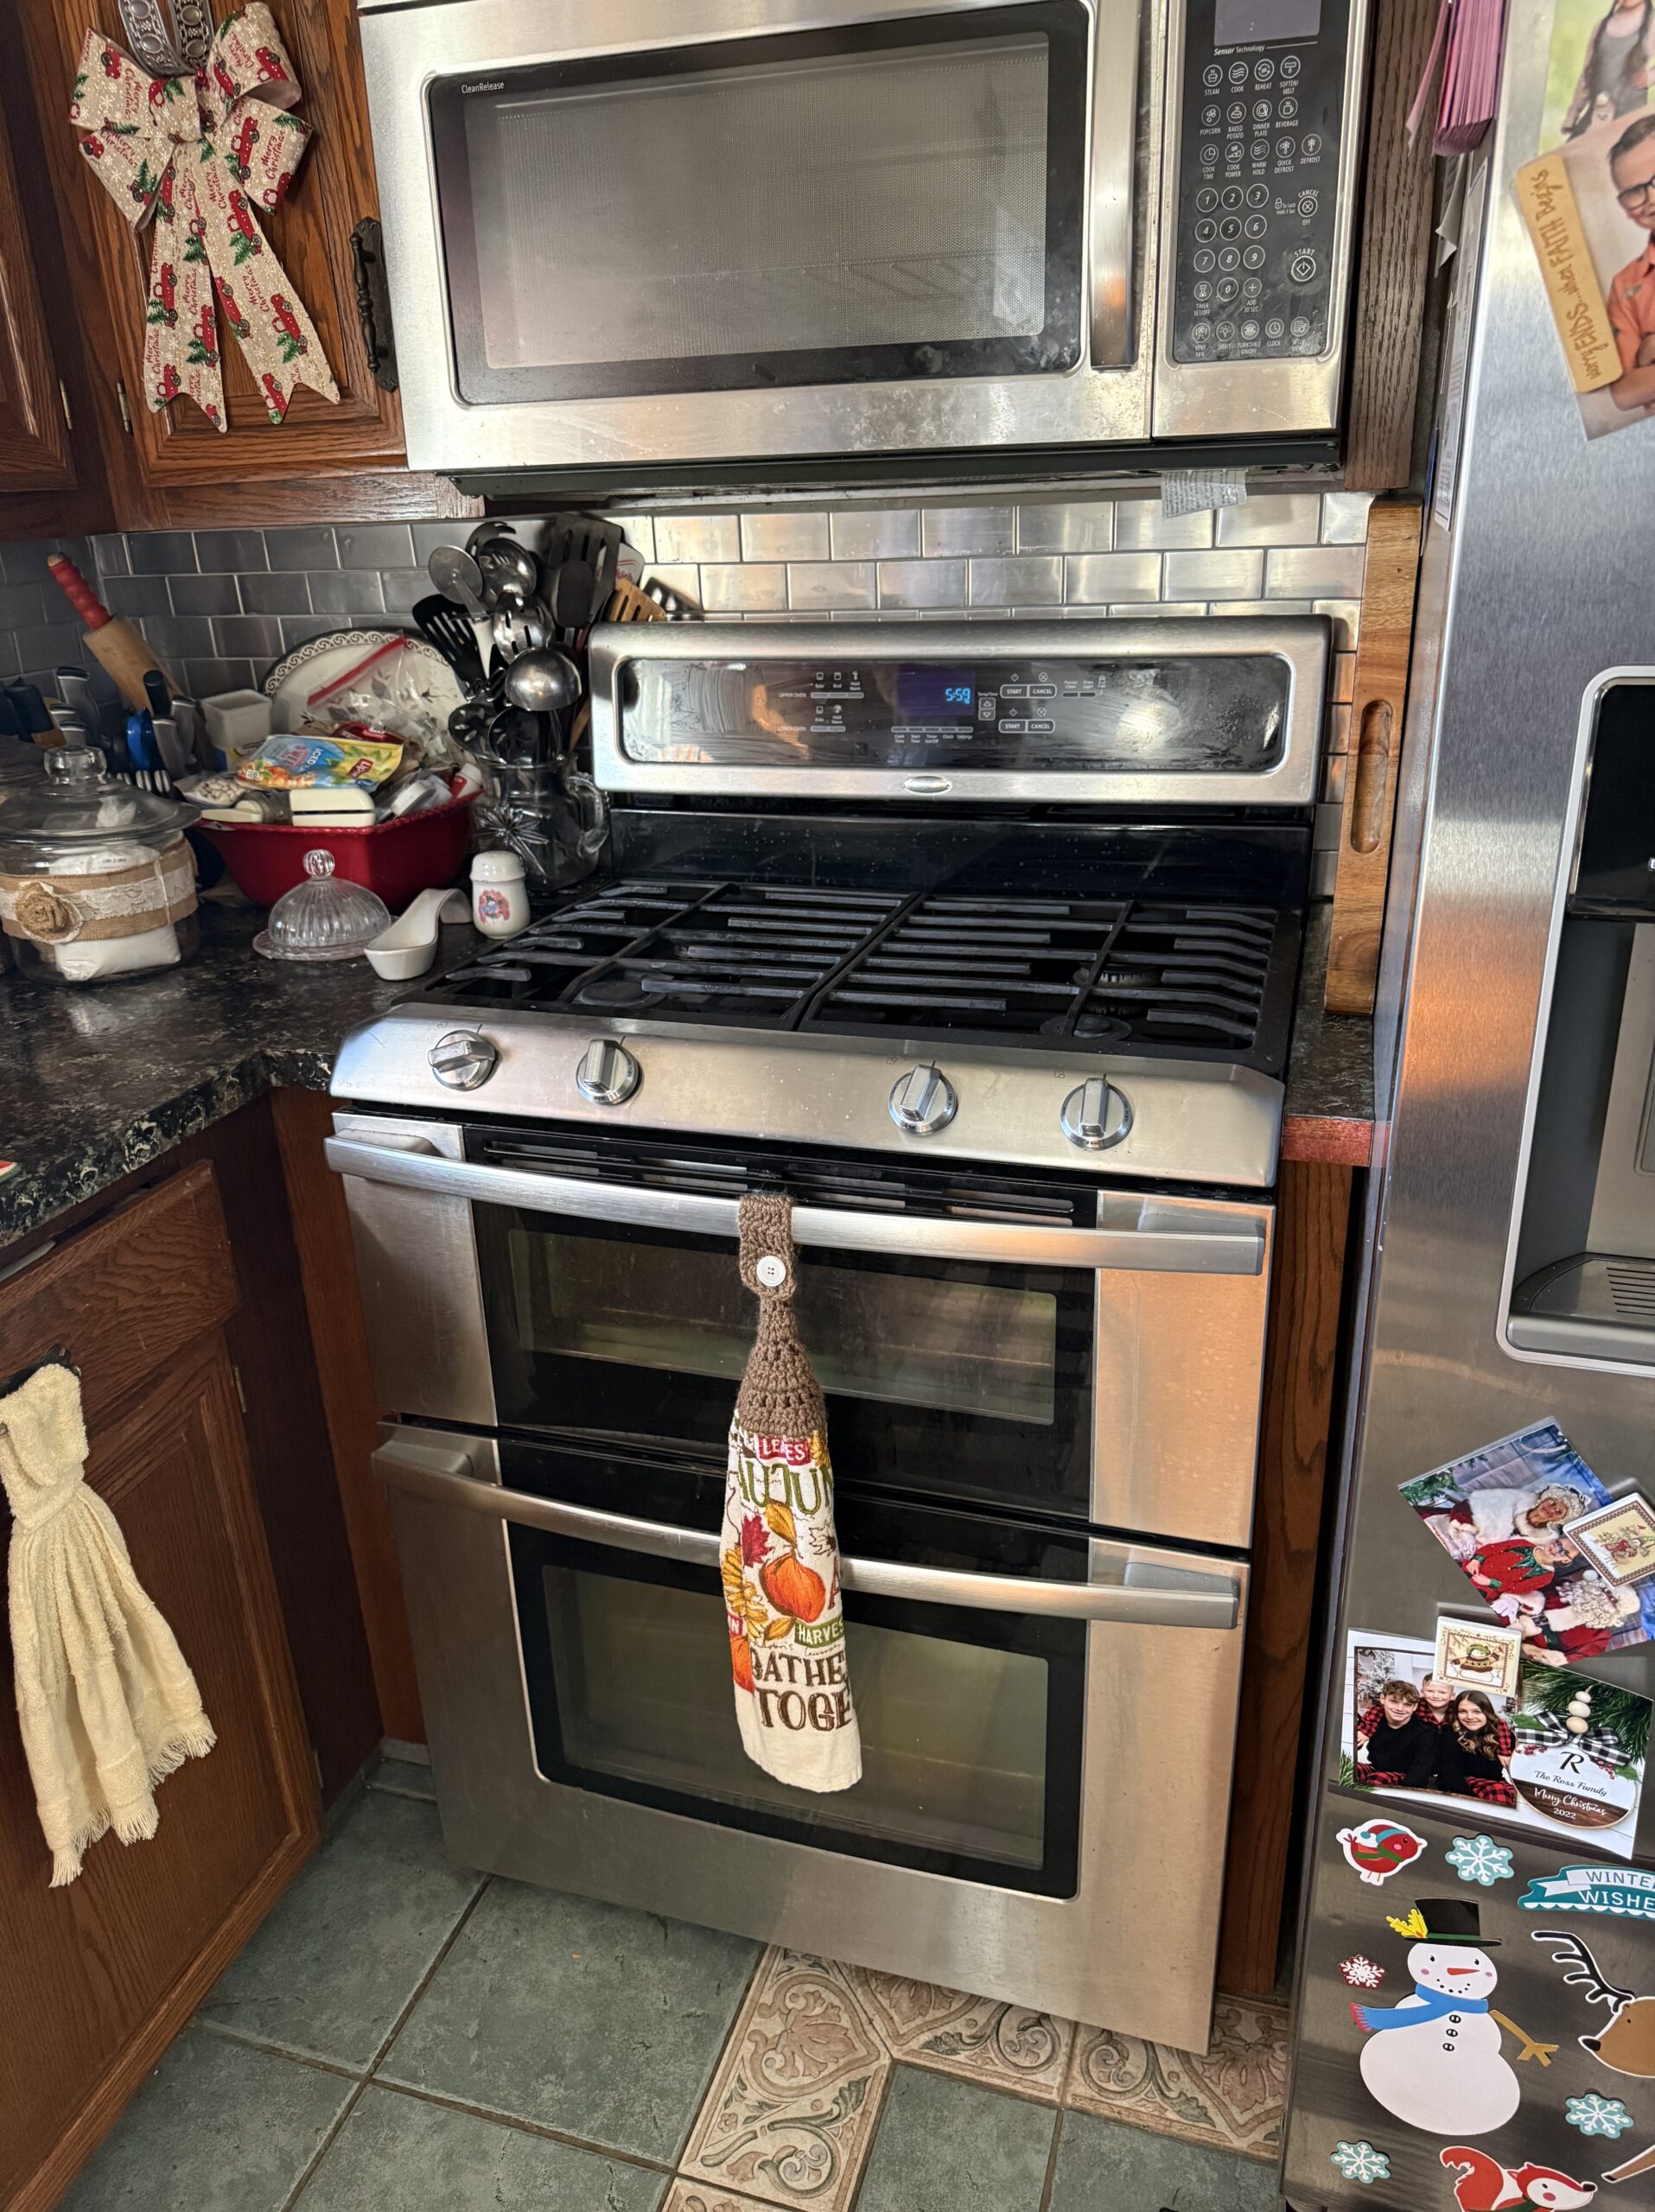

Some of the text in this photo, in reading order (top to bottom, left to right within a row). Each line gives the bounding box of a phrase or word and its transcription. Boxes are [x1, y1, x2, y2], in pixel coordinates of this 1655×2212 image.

[1213, 45, 1265, 56] Sensor Technology
[124, 68, 136, 119] Christmas
[133, 81, 143, 114] Merry
[461, 81, 504, 93] CleanRelease
[1200, 127, 1221, 136] POPCORN
[1276, 120, 1299, 129] BEVERAGE
[113, 133, 136, 156] Merry
[261, 134, 277, 167] Merry
[264, 130, 285, 180] Christmas
[180, 168, 189, 198] Merry
[206, 172, 217, 202] Merry
[209, 161, 226, 209] Christmas
[1299, 189, 1319, 198] CANCEL
[1229, 194, 1235, 202] 2
[1530, 169, 1563, 221] Begins
[1204, 226, 1208, 235] 4
[1228, 225, 1233, 233] 5
[1253, 222, 1258, 231] 6
[1295, 248, 1315, 257] START
[1538, 217, 1575, 268] FAITH
[1203, 257, 1207, 265] 7
[182, 274, 191, 303] Merry
[243, 275, 258, 306] Merry
[245, 264, 270, 313] Christmas
[1580, 342, 1609, 380] worry
[945, 688, 971, 704] 5:59
[307, 748, 323, 765] ICED
[1560, 1751, 1585, 1775] R
[1535, 1770, 1607, 1797] The Ross Family
[1534, 1787, 1607, 1816] Merry Christmas
[1553, 1808, 1577, 1820] 2022
[1578, 1891, 1655, 1910] WISHE
